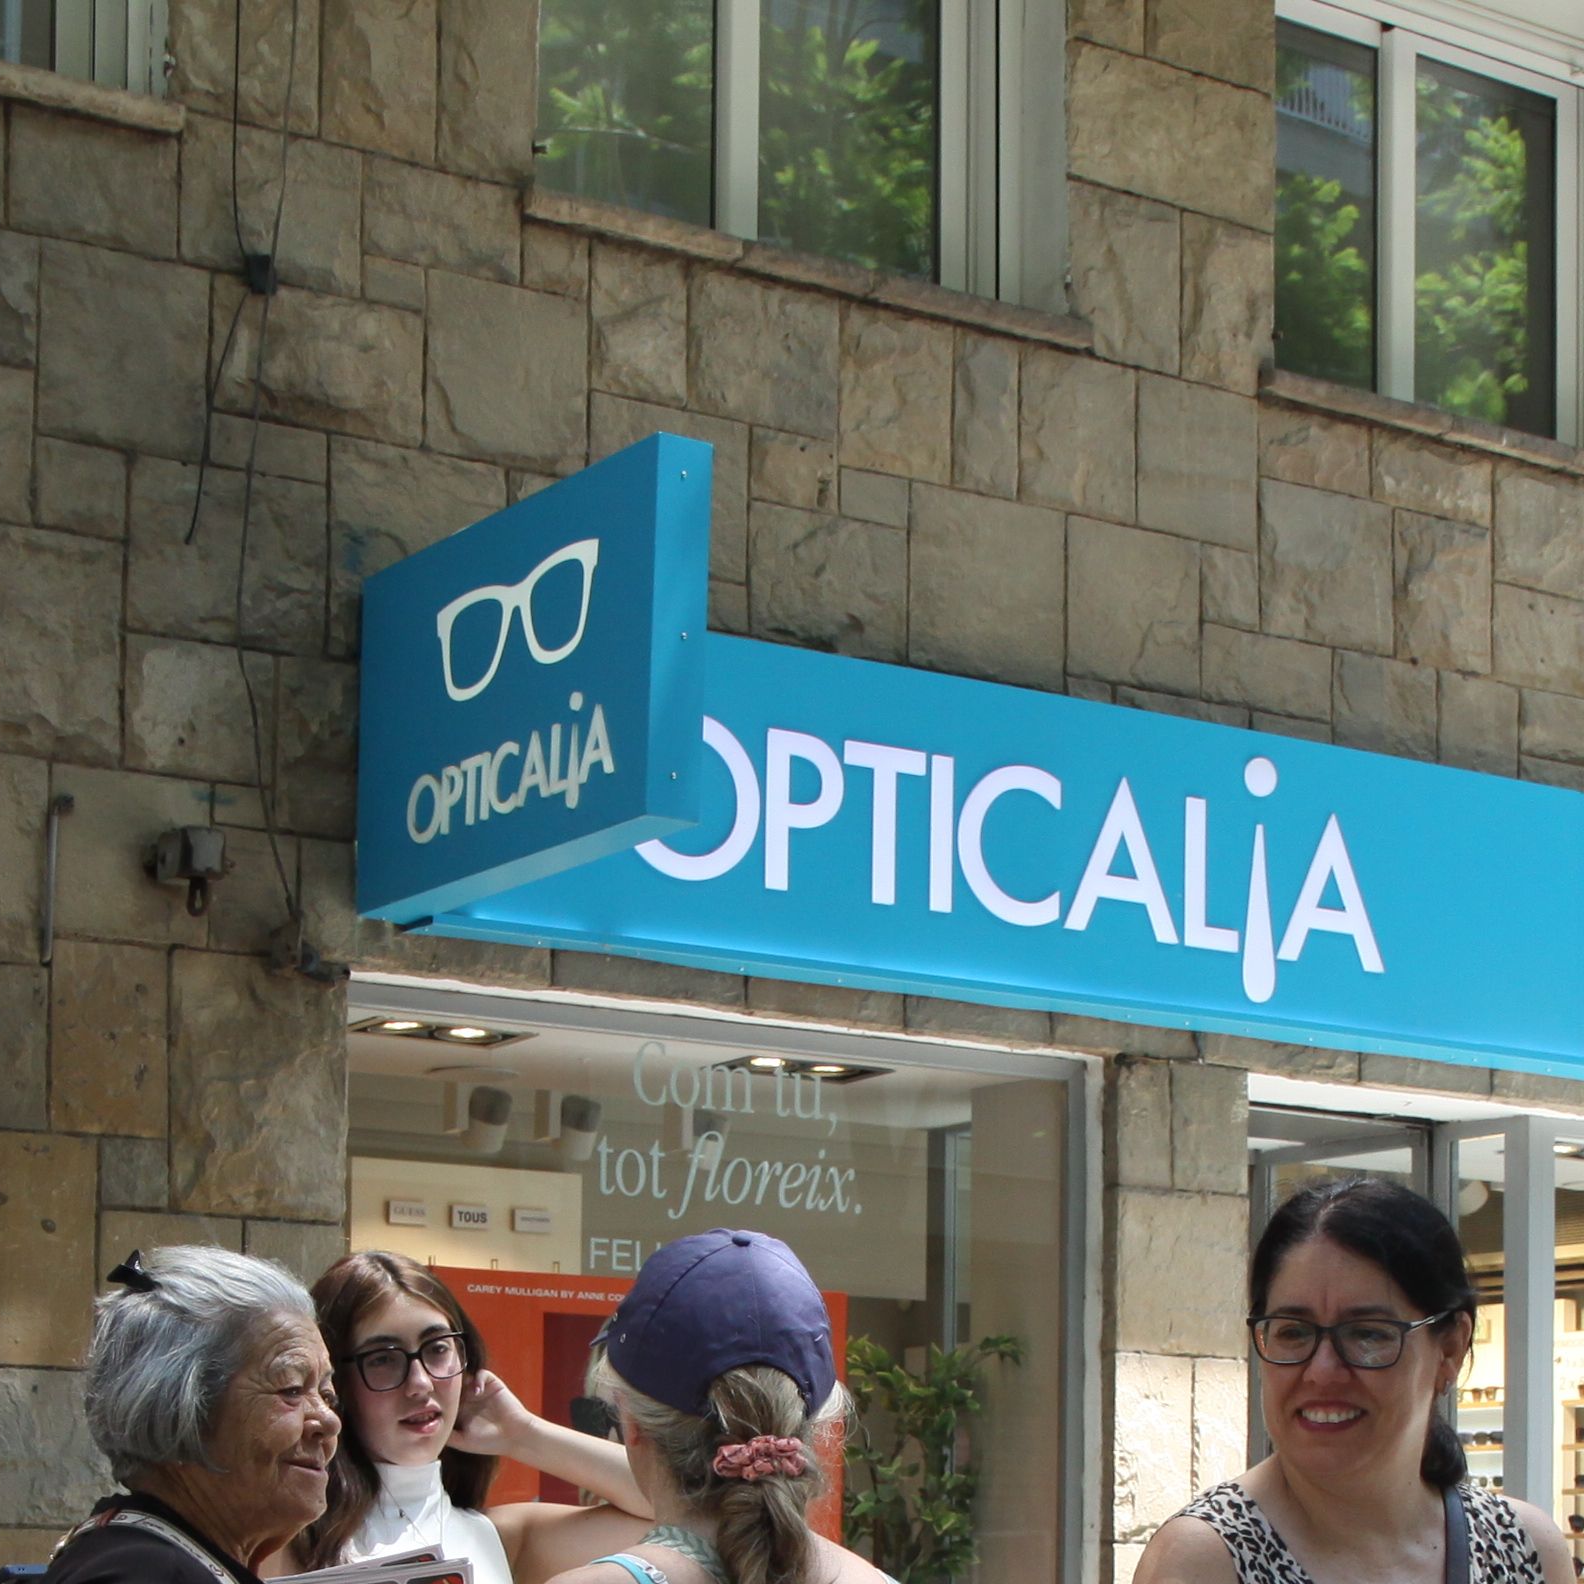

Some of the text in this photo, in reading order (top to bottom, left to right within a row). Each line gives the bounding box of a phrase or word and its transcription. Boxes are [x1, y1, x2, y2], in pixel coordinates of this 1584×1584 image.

[633, 1041, 839, 1136] Com tu,
[597, 1130, 863, 1220] tot floreix.
[457, 1210, 488, 1224] TOUS
[467, 1283, 503, 1295] CAREY
[504, 1286, 559, 1298] MULLIGAN
[560, 1289, 576, 1299] BY
[577, 1290, 606, 1301] ANNE
